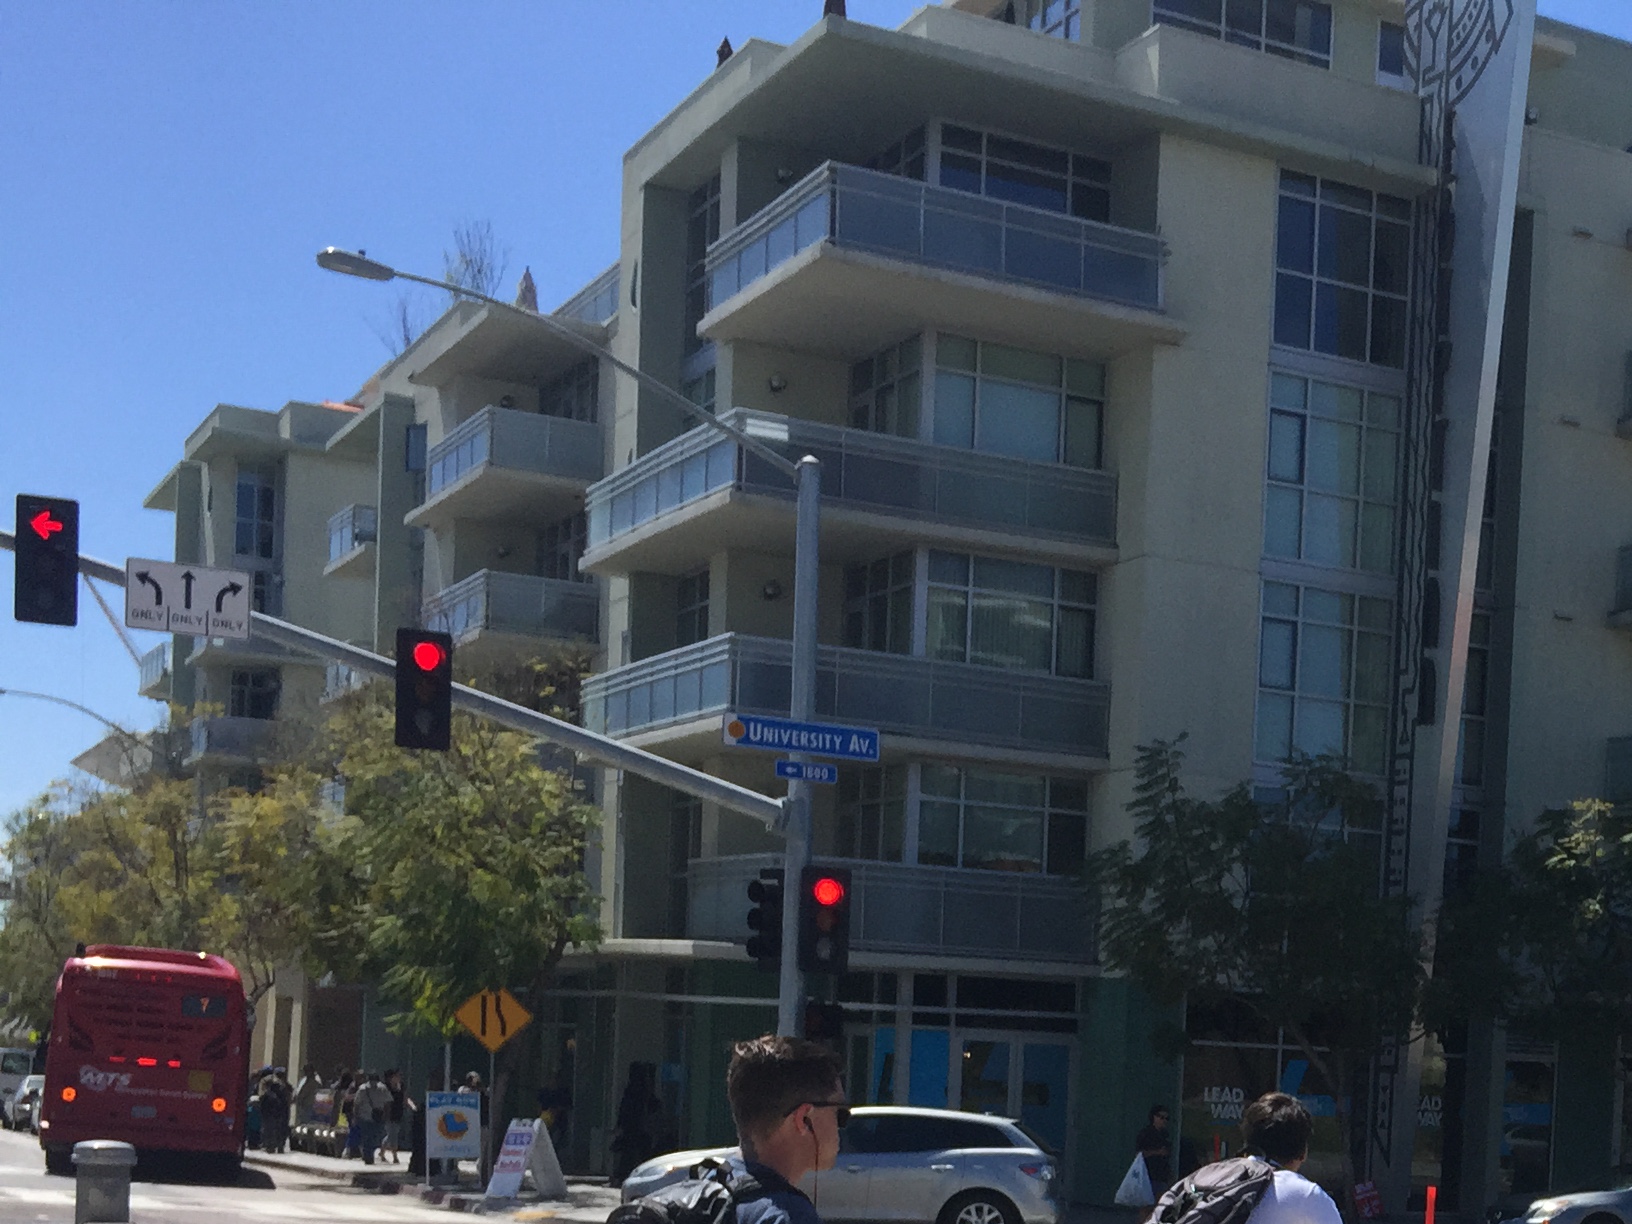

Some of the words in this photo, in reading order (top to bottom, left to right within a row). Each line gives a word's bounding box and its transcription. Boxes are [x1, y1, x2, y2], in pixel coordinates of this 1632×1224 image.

[131, 608, 164, 622] ONLY
[171, 612, 203, 626] ONLY
[212, 617, 244, 632] ONLY
[749, 721, 843, 751] UNIVERSITY
[849, 734, 875, 755] AV.
[802, 766, 829, 780] 1800
[82, 1071, 133, 1087] MTS
[1203, 1086, 1244, 1102] LEAD
[1210, 1103, 1245, 1119] WAY
[1418, 1095, 1442, 1111] AD
